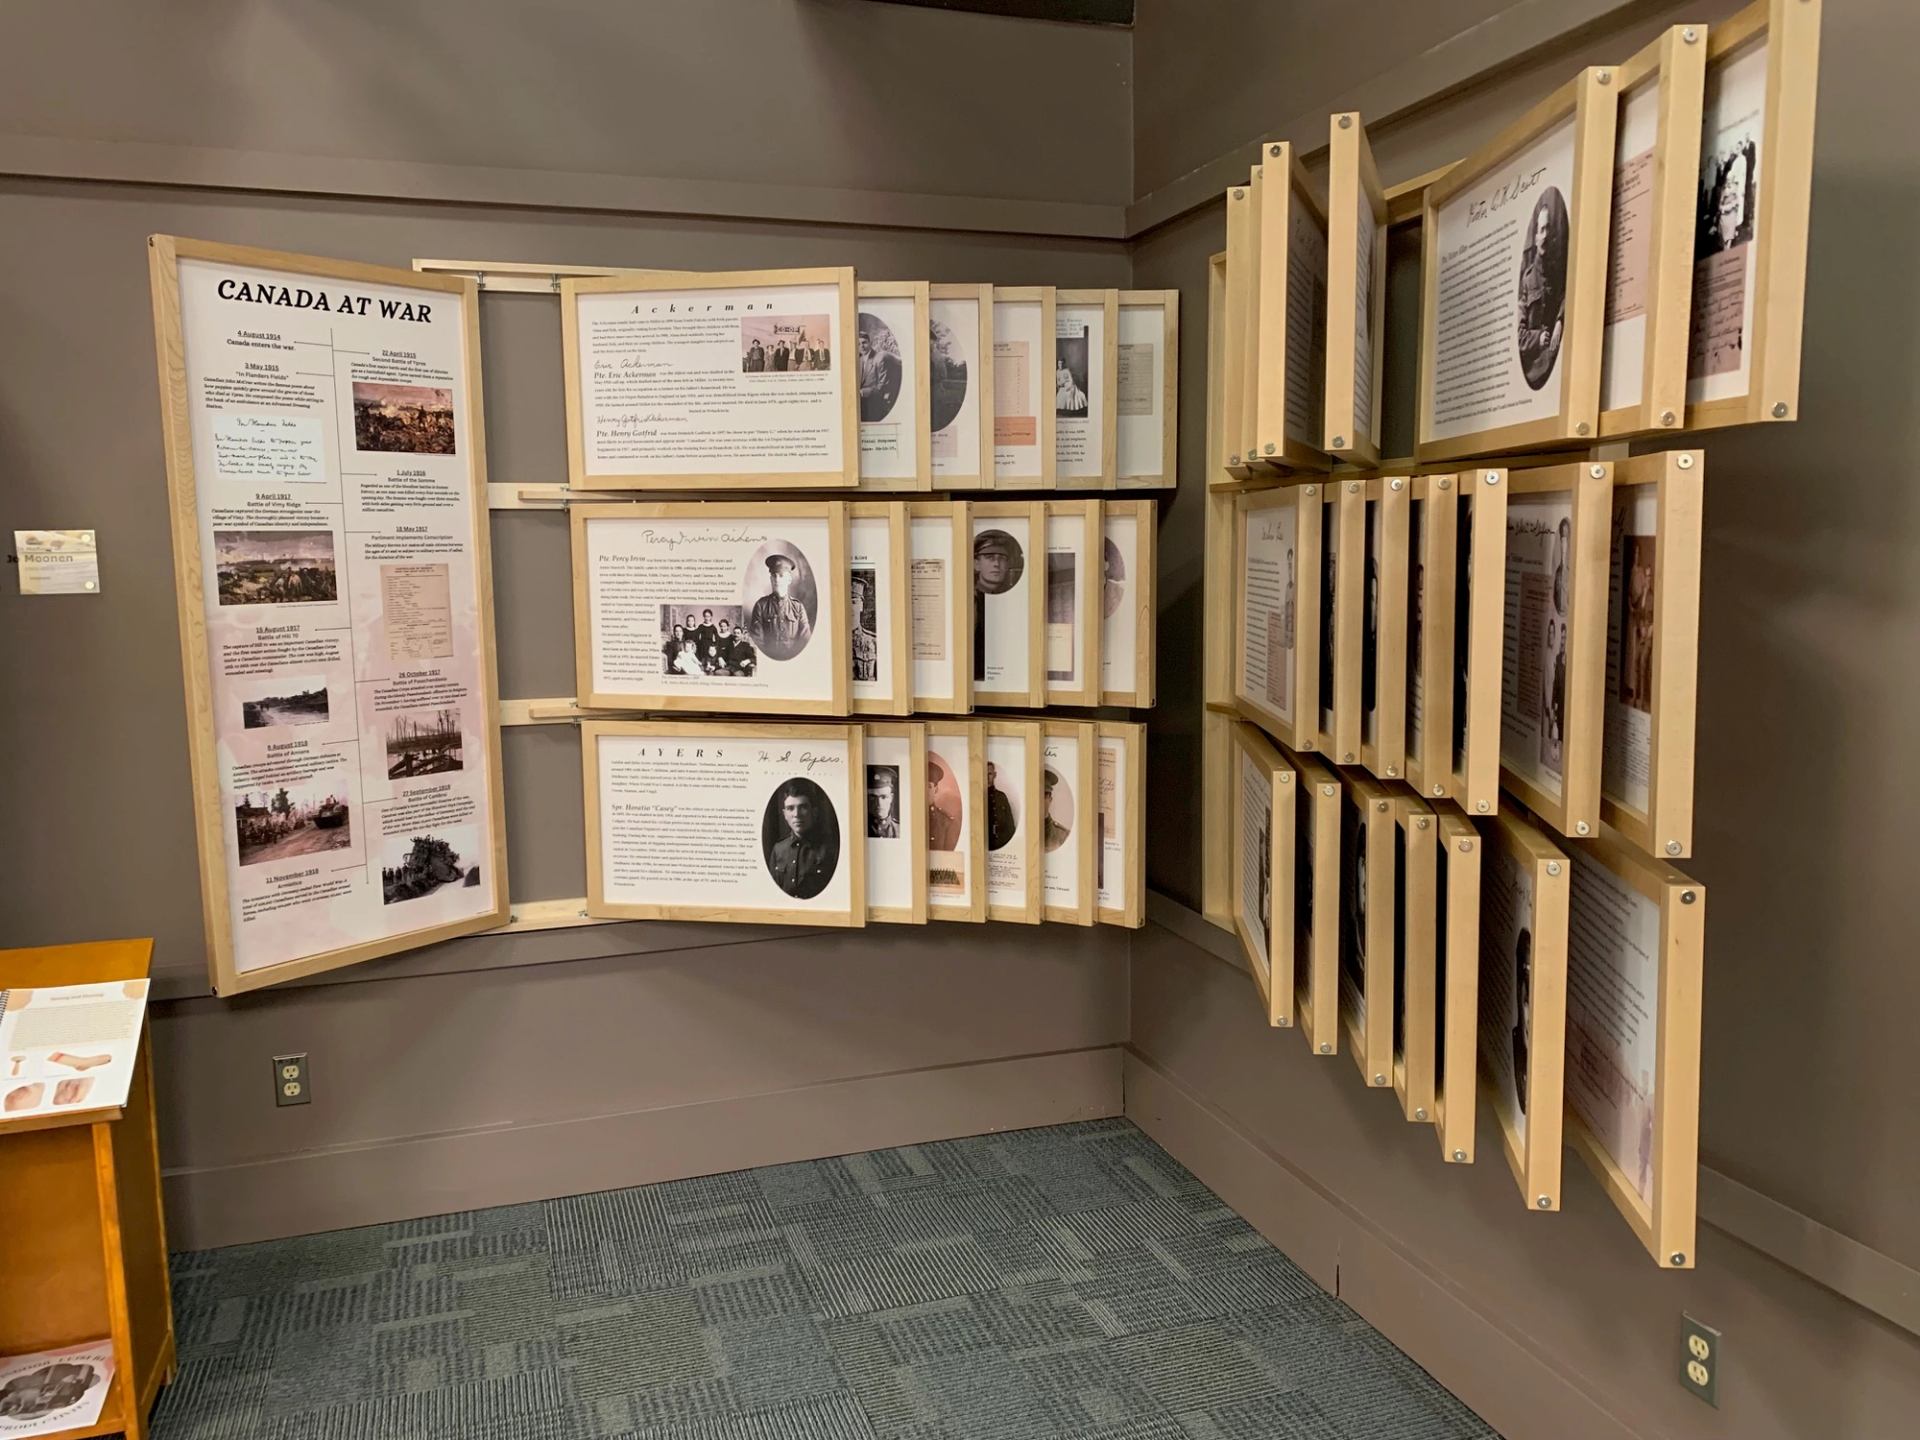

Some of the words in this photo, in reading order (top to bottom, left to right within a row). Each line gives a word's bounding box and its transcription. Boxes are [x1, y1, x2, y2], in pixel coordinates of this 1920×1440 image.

[218, 279, 330, 311] CANADA
[336, 293, 372, 316] AT
[378, 299, 431, 323] WAR
[631, 302, 774, 314] Ackerman
[226, 338, 249, 346] Canada
[251, 340, 270, 348] enters
[638, 748, 724, 758] AYERS
